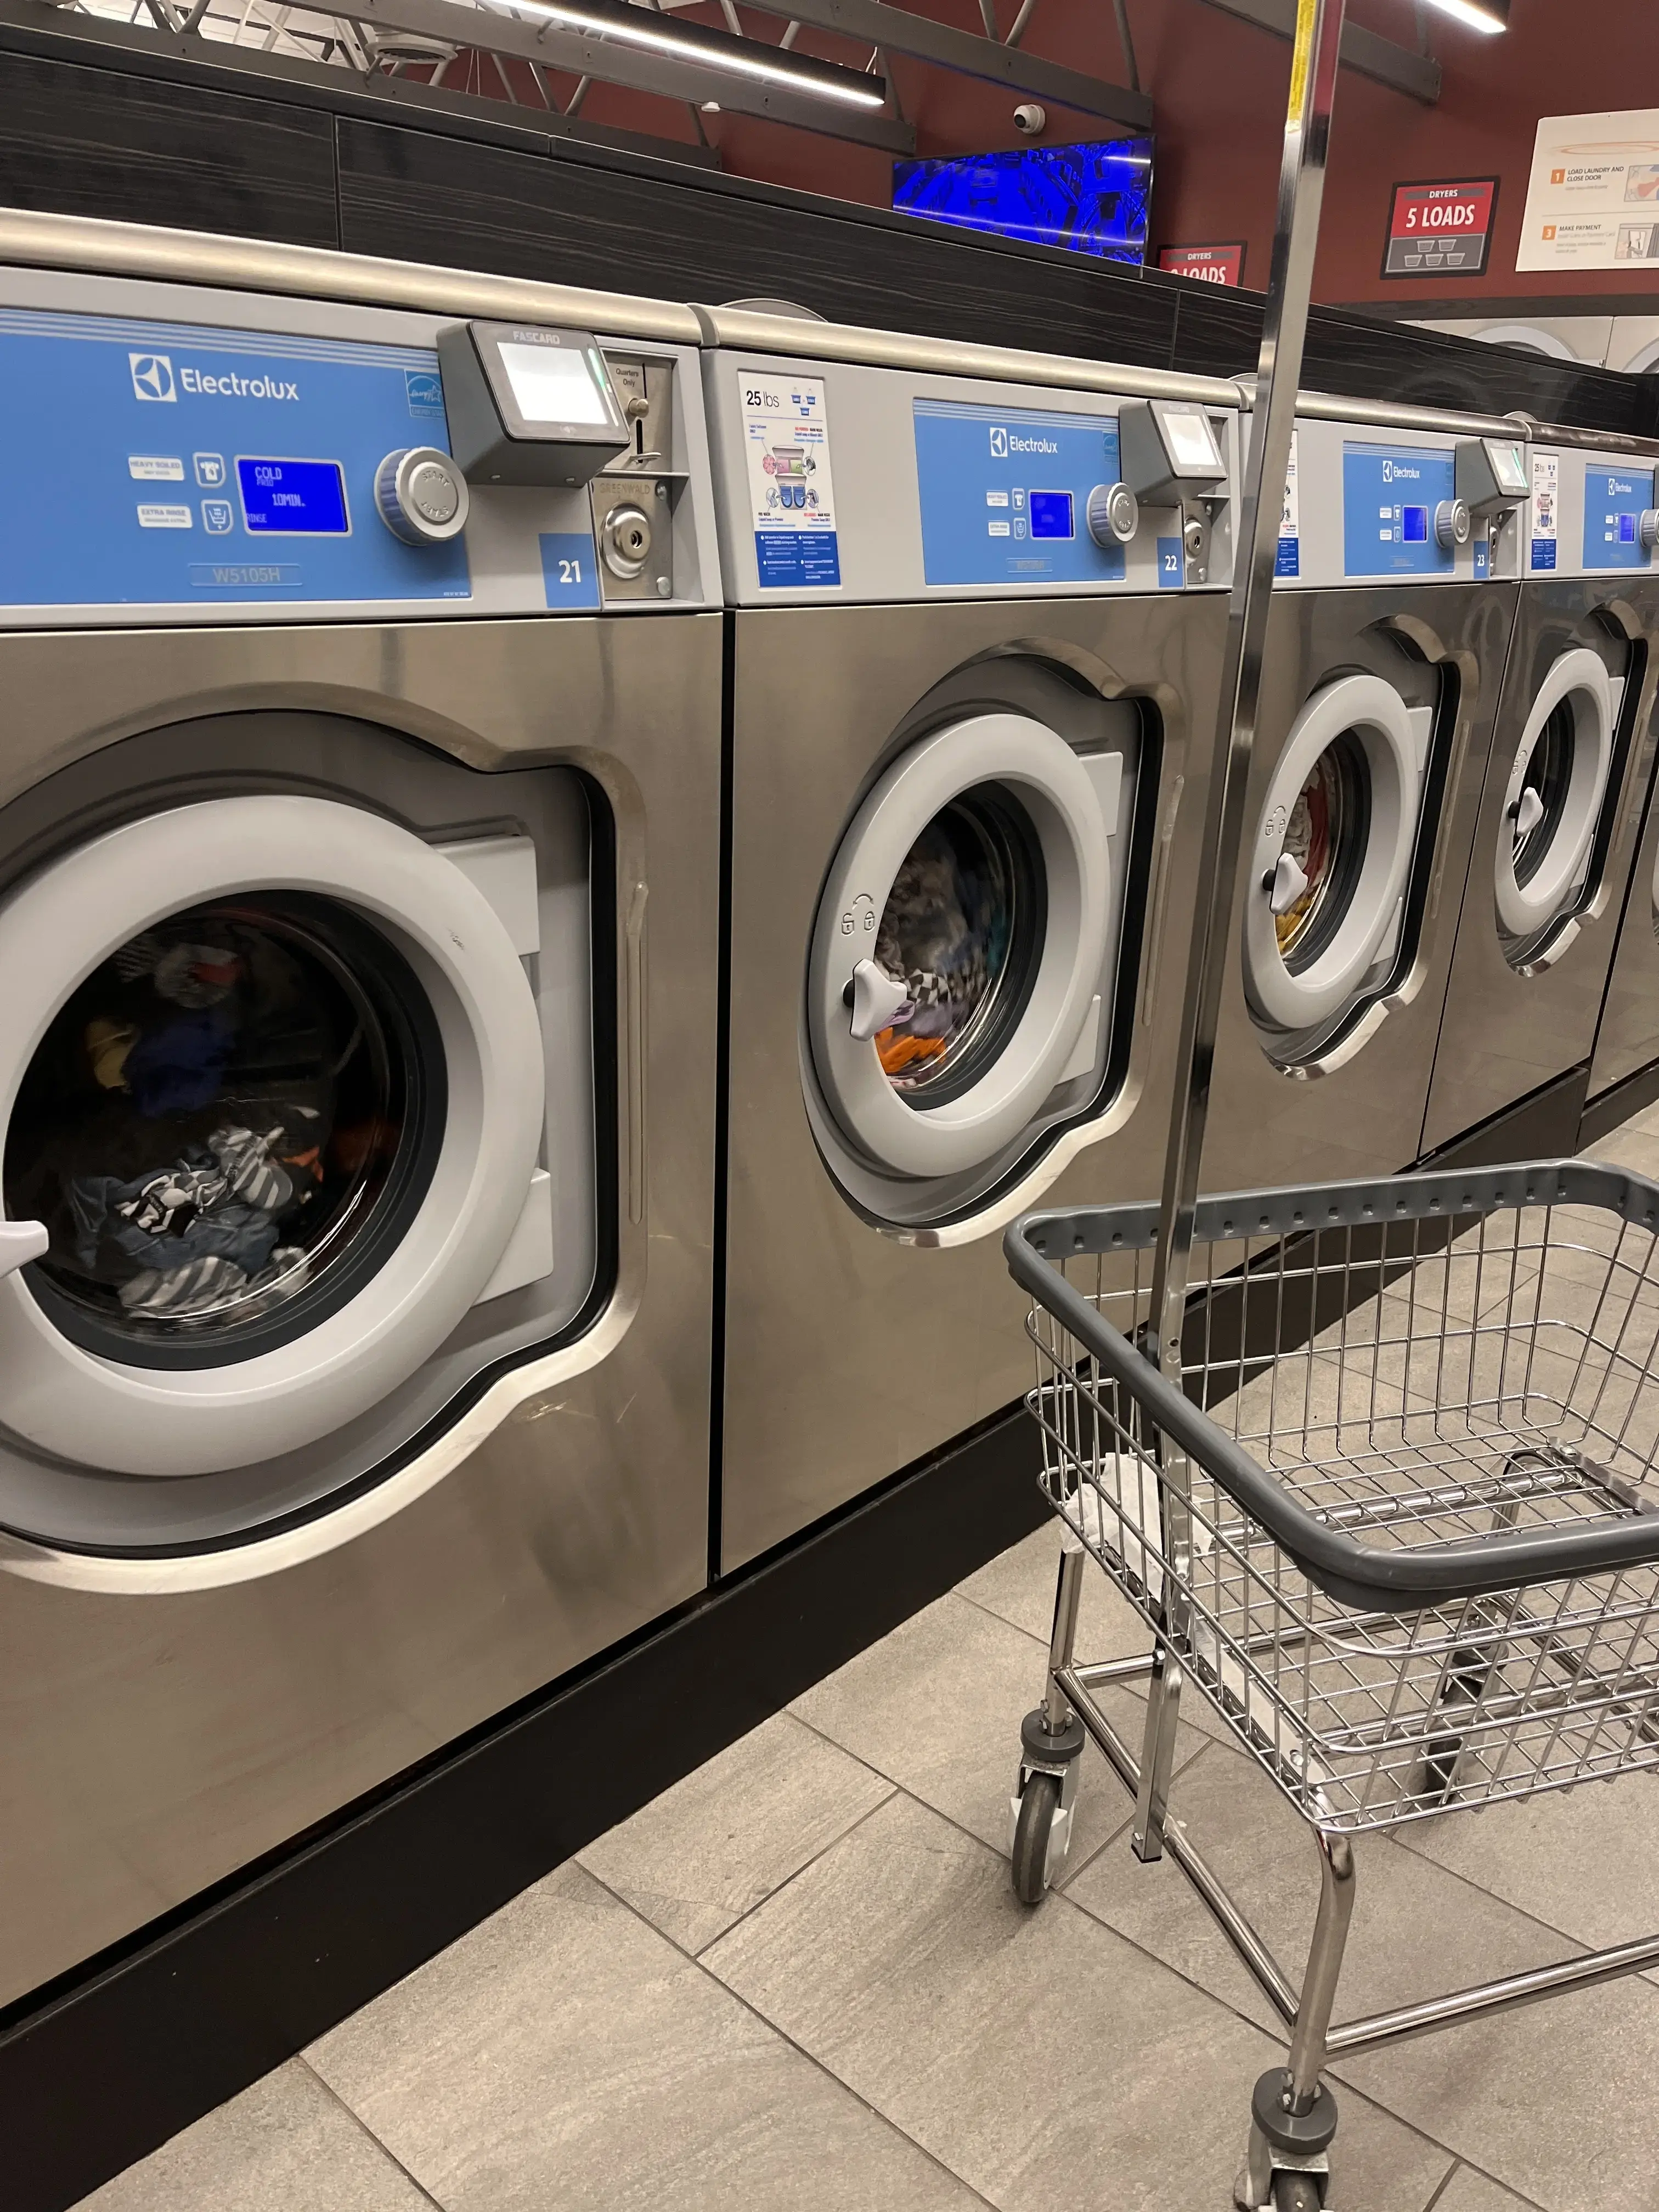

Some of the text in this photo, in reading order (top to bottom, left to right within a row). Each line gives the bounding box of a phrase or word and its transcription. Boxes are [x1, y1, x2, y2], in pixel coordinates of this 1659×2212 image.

[1555, 172, 1560, 182] 1
[1429, 189, 1458, 199] DRYERS
[1406, 204, 1475, 228] 5 LOADS
[1546, 229, 1551, 238] 3
[1187, 252, 1212, 261] DRYERS
[512, 330, 560, 345] FASCARD
[616, 368, 639, 377] Quarters
[180, 368, 300, 400] Electrolux
[623, 378, 635, 387] Only
[746, 390, 780, 408] 25 lbs
[1009, 435, 1058, 454] Electrolux
[255, 466, 283, 480] COLD
[422, 470, 450, 487] START
[1393, 466, 1421, 479] Electrolux
[599, 482, 651, 495] GREENWALD
[1165, 555, 1177, 571] 22
[1477, 555, 1485, 567] 23
[212, 567, 280, 583] W5105H
[558, 560, 582, 583] 21
